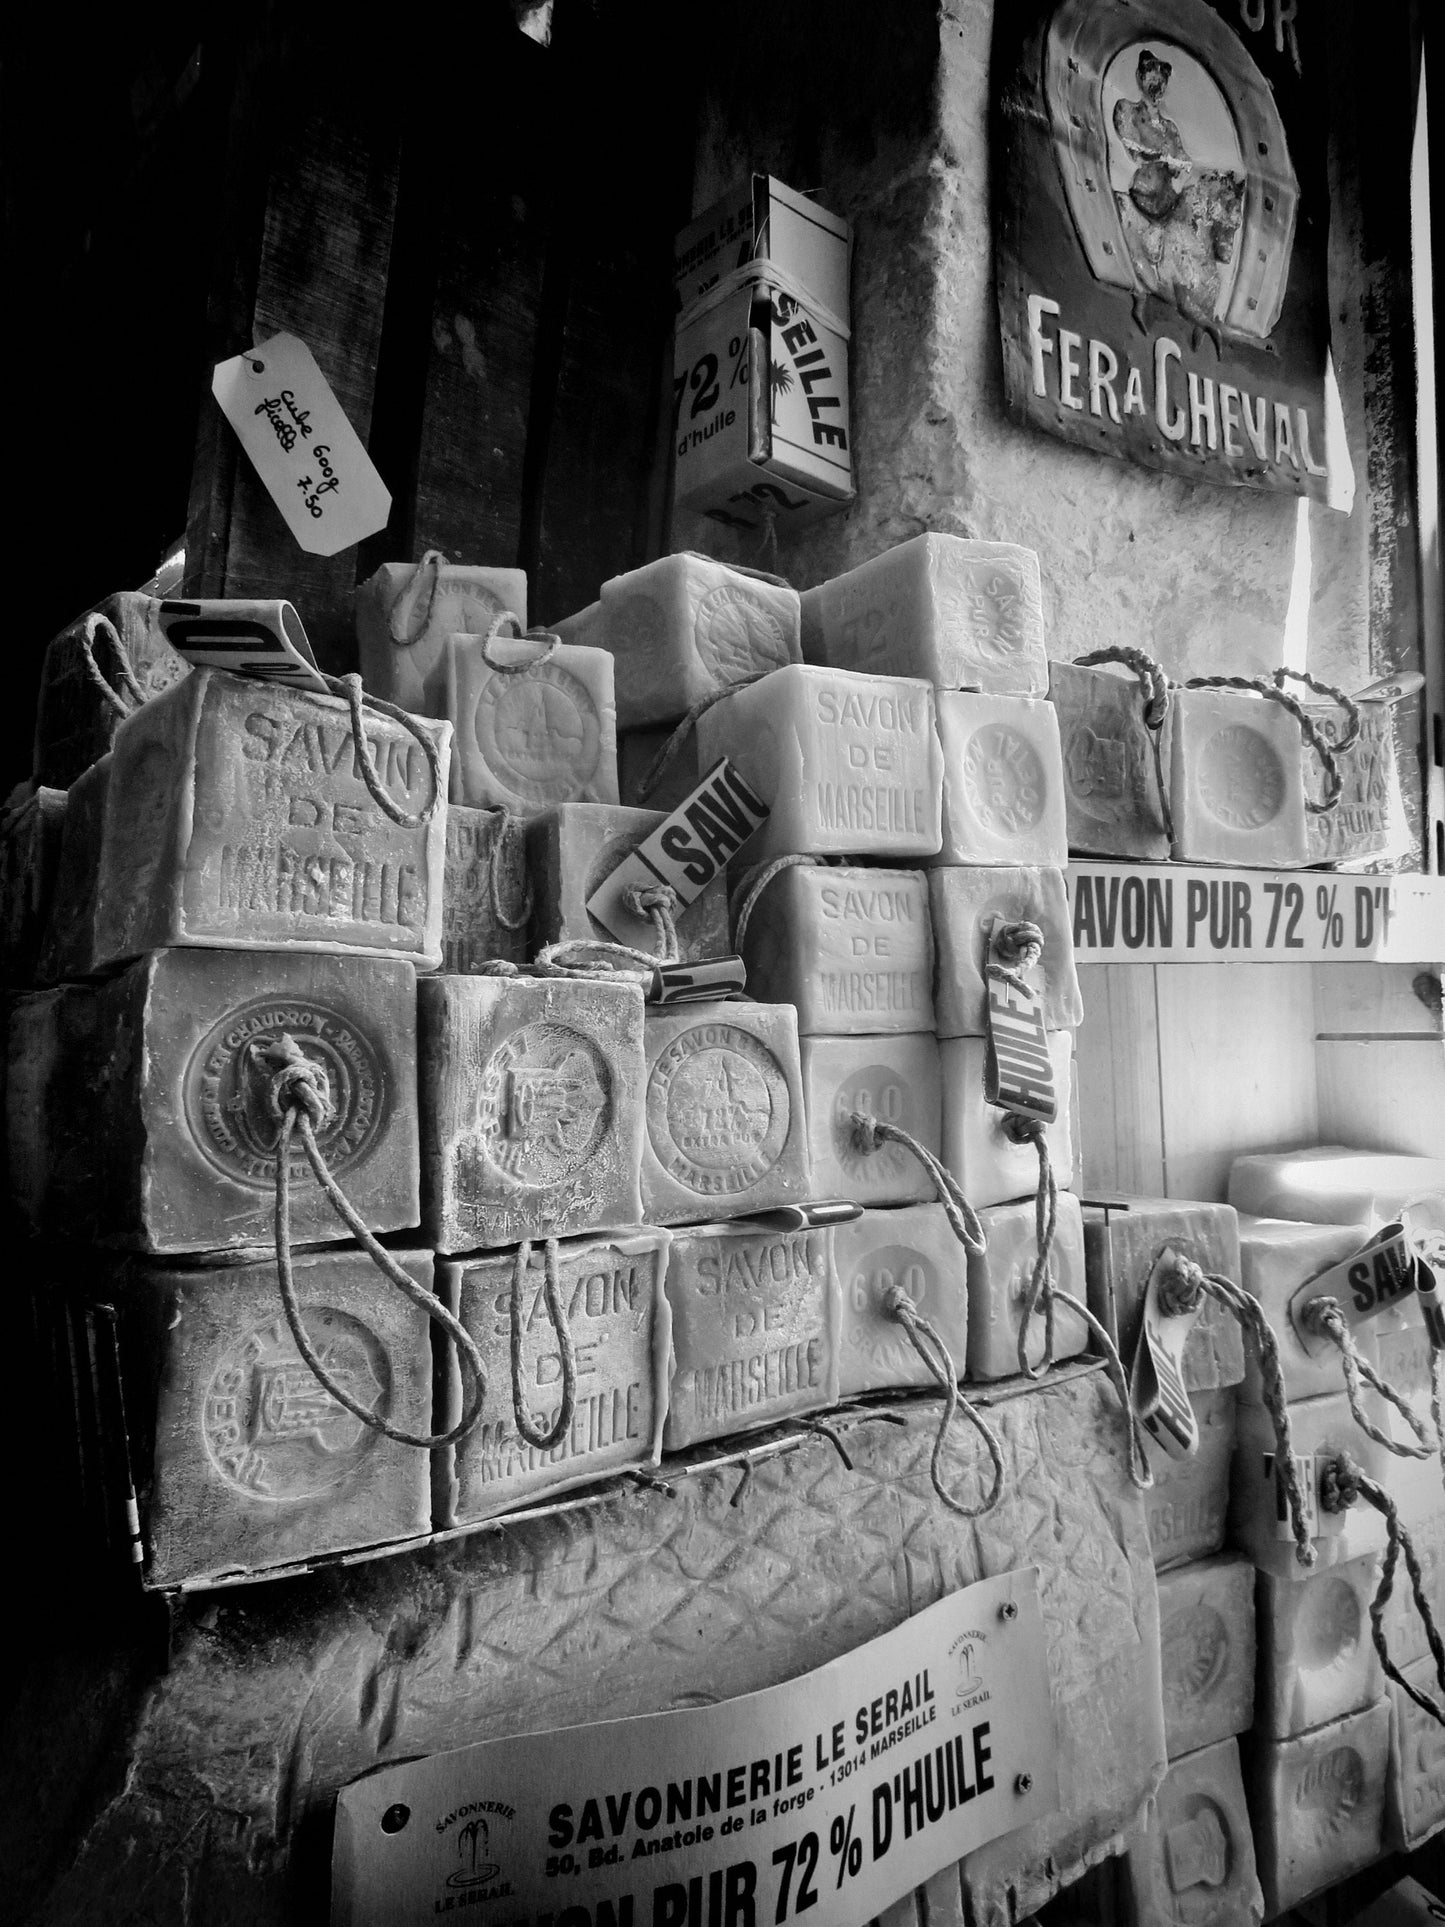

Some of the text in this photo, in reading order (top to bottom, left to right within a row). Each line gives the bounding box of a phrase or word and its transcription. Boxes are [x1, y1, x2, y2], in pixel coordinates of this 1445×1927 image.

[1028, 294, 1328, 478] FER A CHEVAL
[678, 408, 737, 457] d'huile
[312, 445, 340, 494] 600g
[296, 475, 323, 519] 7.50
[818, 691, 920, 733] SAVON
[849, 744, 891, 770] DE
[288, 798, 366, 835] DE
[817, 782, 927, 834] MARSEILLE
[820, 888, 914, 923] SAVON
[1186, 879, 1252, 949] PUR
[1263, 882, 1304, 949] 72
[1316, 883, 1344, 949] %
[851, 936, 890, 957] DE
[820, 970, 919, 1012] MARSEILLE
[225, 1010, 328, 1049] CHAUDRON
[669, 1027, 732, 1064] SAVON
[696, 1239, 813, 1297] SAVON
[735, 1302, 786, 1337] DE
[206, 1366, 271, 1490] SERAIL
[548, 1668, 935, 1850] SAVONNERIE LE SERAIL
[588, 1843, 625, 1869] Bd.
[631, 1824, 715, 1860] Anatole
[720, 1815, 745, 1837] de
[750, 1806, 767, 1827] la
[773, 1784, 815, 1818] forge
[830, 1751, 867, 1787] 13014
[870, 1704, 938, 1761] MARSEILLE
[435, 1800, 517, 1834] SAVONNERIE
[772, 1831, 820, 1927] 72
[829, 1803, 863, 1891] %
[871, 1720, 996, 1863] D'HUILE
[434, 1882, 516, 1914] LE SERAIL
